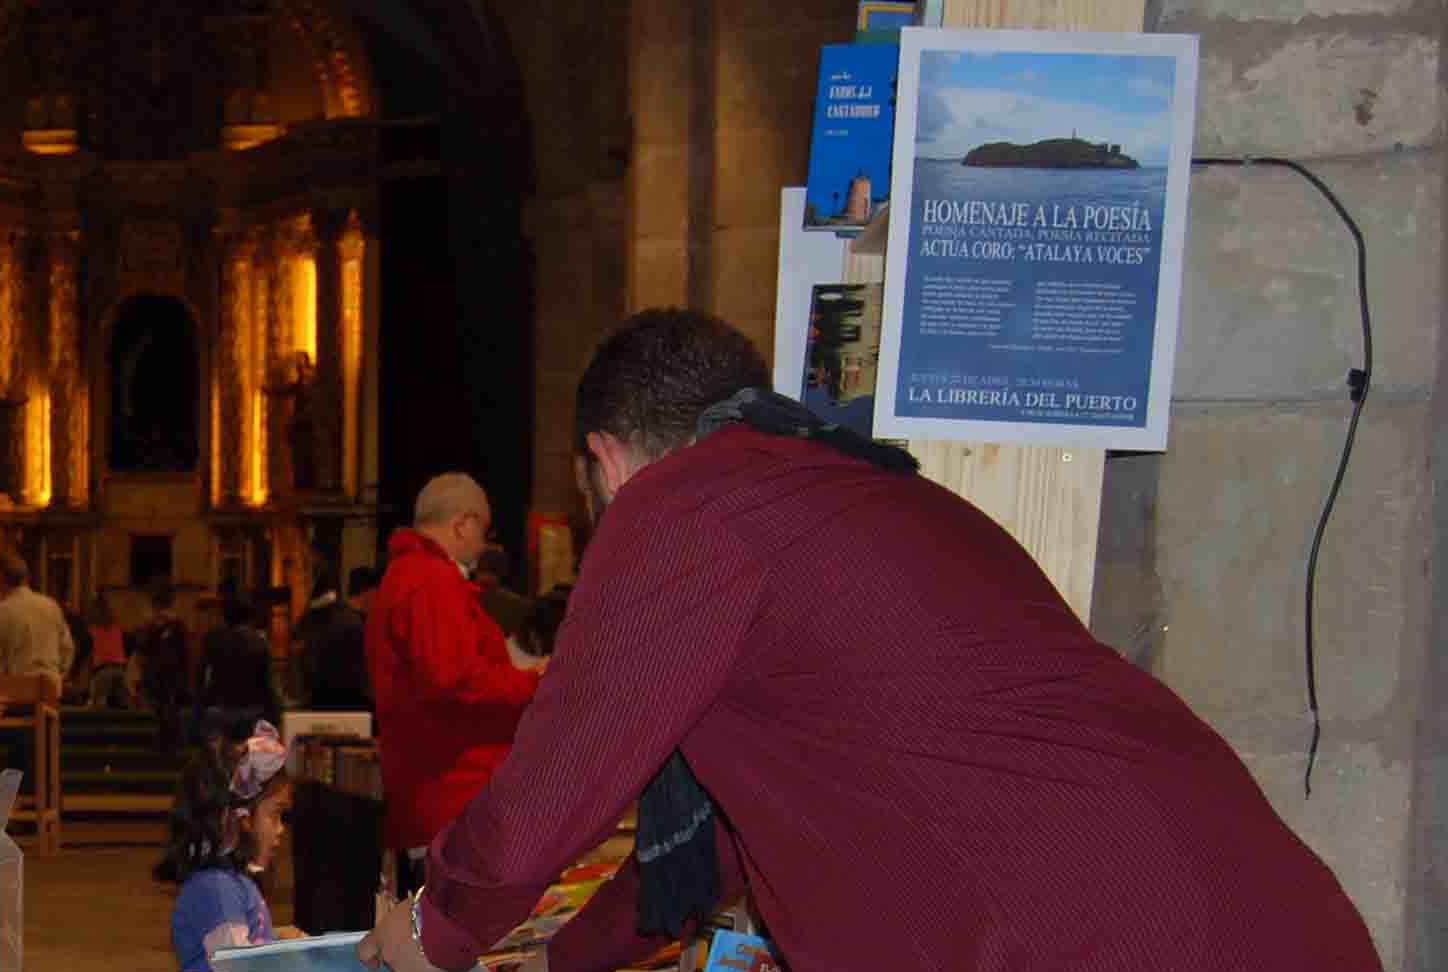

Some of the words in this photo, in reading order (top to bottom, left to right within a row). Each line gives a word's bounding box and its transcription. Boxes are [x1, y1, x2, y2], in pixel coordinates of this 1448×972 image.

[923, 200, 1030, 226] HOMENAJE
[1032, 203, 1047, 228] A
[1053, 204, 1077, 229] LA
[1084, 200, 1152, 232] POESÍA
[908, 386, 931, 402] LA
[937, 386, 1020, 407] LIBRERÍA
[1024, 391, 1061, 409] DEL
[1064, 394, 1137, 411] PUERTO
